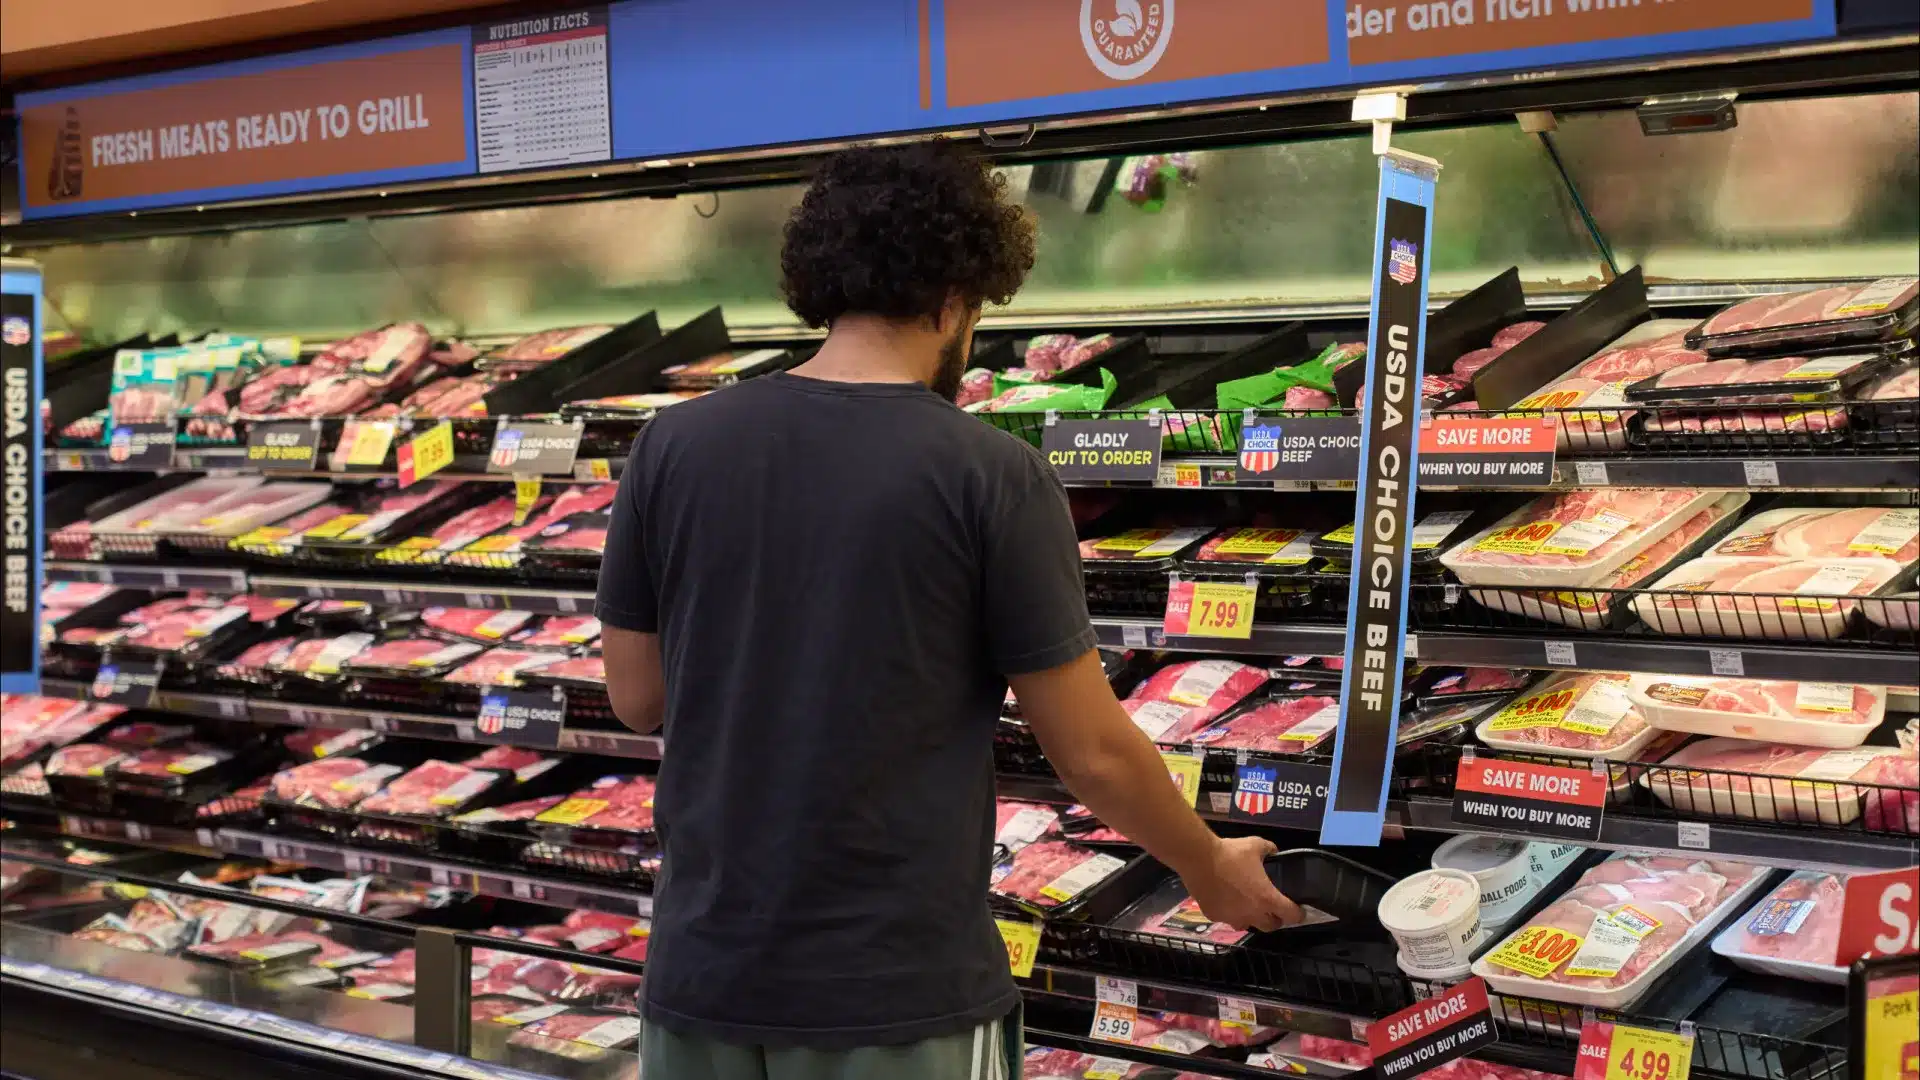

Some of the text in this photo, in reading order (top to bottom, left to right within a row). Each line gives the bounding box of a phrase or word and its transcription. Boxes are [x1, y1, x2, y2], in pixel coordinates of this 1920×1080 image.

[489, 12, 590, 40] NUTRITION FACTS
[1346, 4, 1396, 38] der
[1407, 0, 1474, 31] and
[1094, 4, 1160, 60] GUARANTEED
[92, 93, 429, 167] FRESH MEATS READY TO GRILL
[1393, 252, 1413, 263] CHOICE
[1074, 432, 1129, 449] GLADLY
[1252, 430, 1270, 439] USDA
[1283, 436, 1316, 448] USDA
[1437, 428, 1532, 445] SAVE MORE
[544, 438, 577, 449] CHOICE
[1247, 440, 1274, 448] CHOICE
[1048, 450, 1152, 465] CUT TO ORDER
[1282, 450, 1312, 463] BEEF
[1419, 462, 1544, 475] WHEN YOU BUY MORE
[5, 367, 28, 613] USDA CHOICE BEEF
[1361, 324, 1409, 711] USDA CHOICE BEEF
[1168, 602, 1190, 613] SALE
[1200, 600, 1239, 628] 7.99
[1516, 691, 1573, 716] 3.00
[506, 706, 561, 722] USDA CHOICE
[505, 718, 527, 729] BEEF
[1247, 771, 1265, 781] USDA
[1482, 768, 1581, 796] SAVE MORE
[1242, 780, 1270, 791] CHOICE
[1278, 782, 1311, 796] USDA
[1277, 797, 1308, 809] BEEF
[1463, 801, 1592, 829] WHEN YOU BUY MORE
[1504, 875, 1527, 896] FOODS
[1874, 882, 1919, 955] S
[1519, 929, 1577, 962] 3.00
[1517, 960, 1550, 973] PACKAGE
[1520, 955, 1549, 966] MORE
[1120, 993, 1137, 1005] 7.49
[1883, 997, 1912, 1020] Pork
[1388, 993, 1468, 1042] SAVE MORE
[1098, 1017, 1130, 1036] 5.99
[1383, 1021, 1488, 1076] WHEN YOU BUY MORE
[1579, 1044, 1607, 1058] SALE
[1620, 1047, 1670, 1080] 4.99
